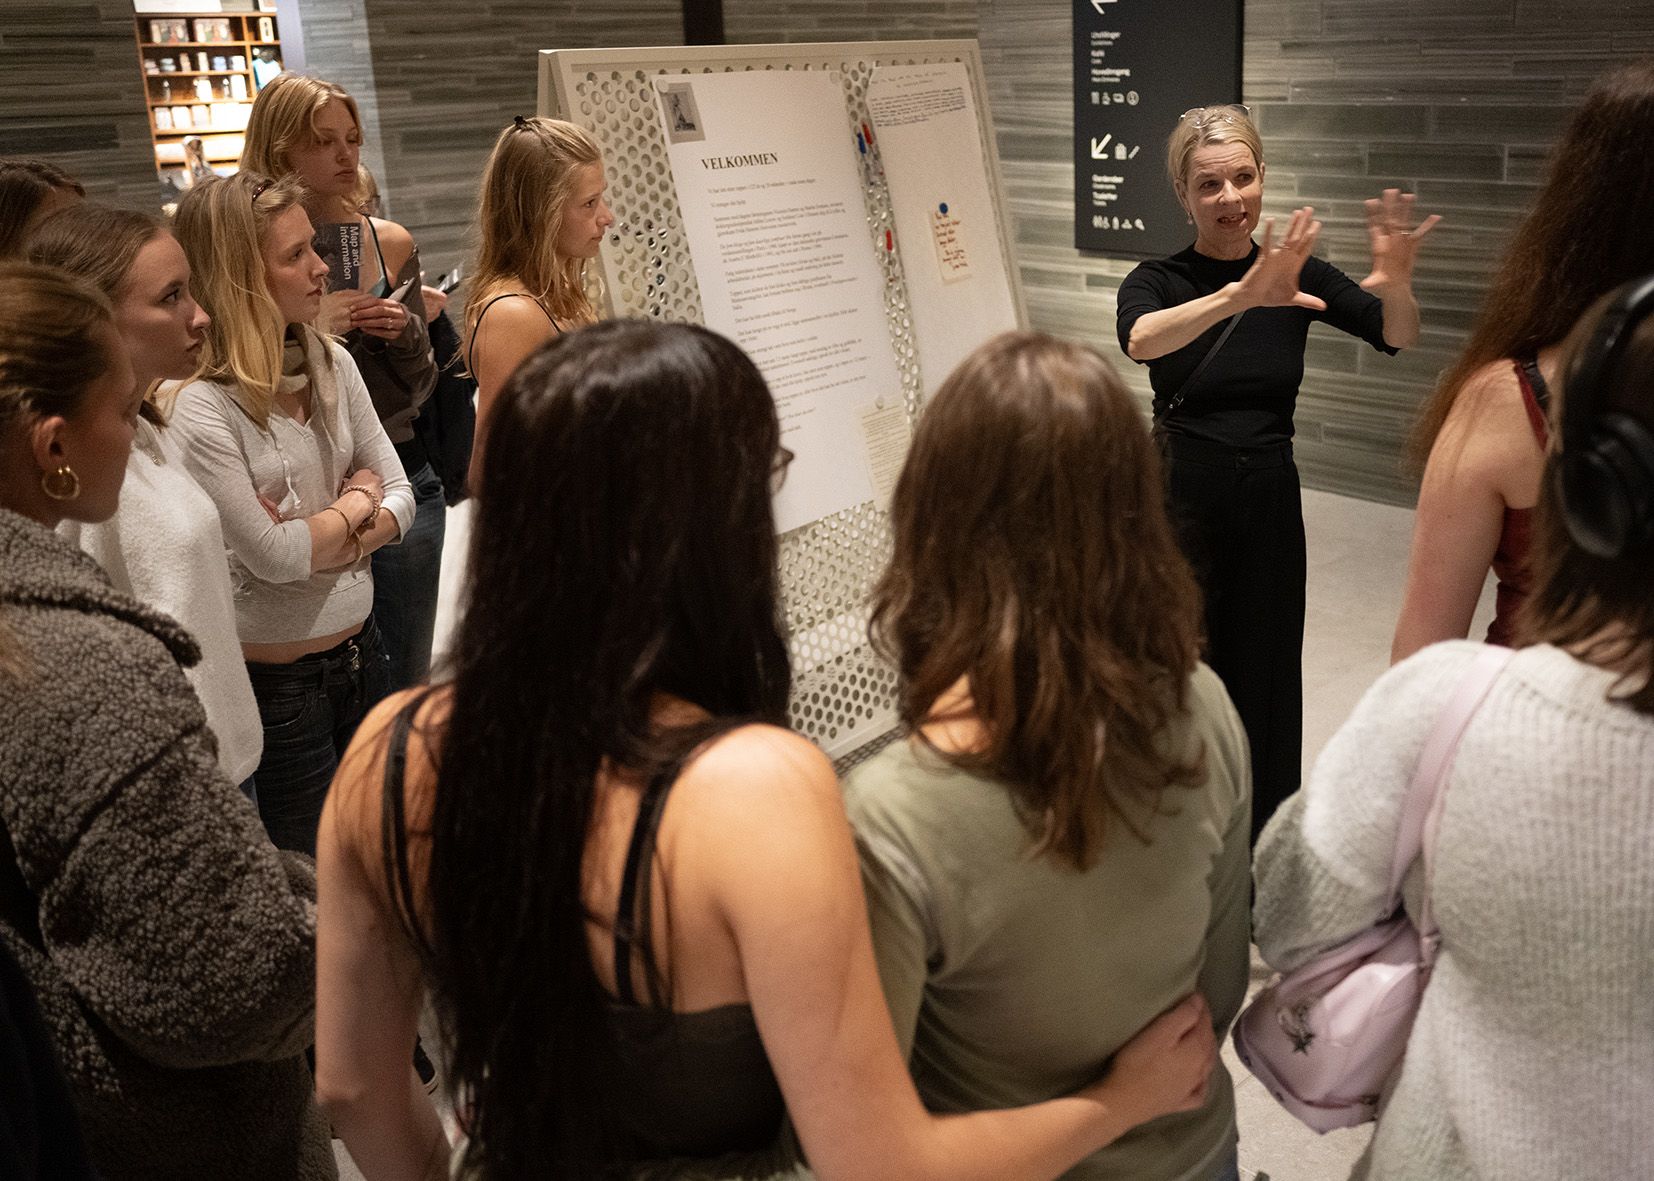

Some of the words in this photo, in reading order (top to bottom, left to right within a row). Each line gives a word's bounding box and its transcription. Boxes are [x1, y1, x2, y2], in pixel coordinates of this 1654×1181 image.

[701, 152, 779, 171] VELKOMMEN
[349, 226, 359, 248] Map
[340, 226, 352, 280] information
[352, 249, 361, 267] and
